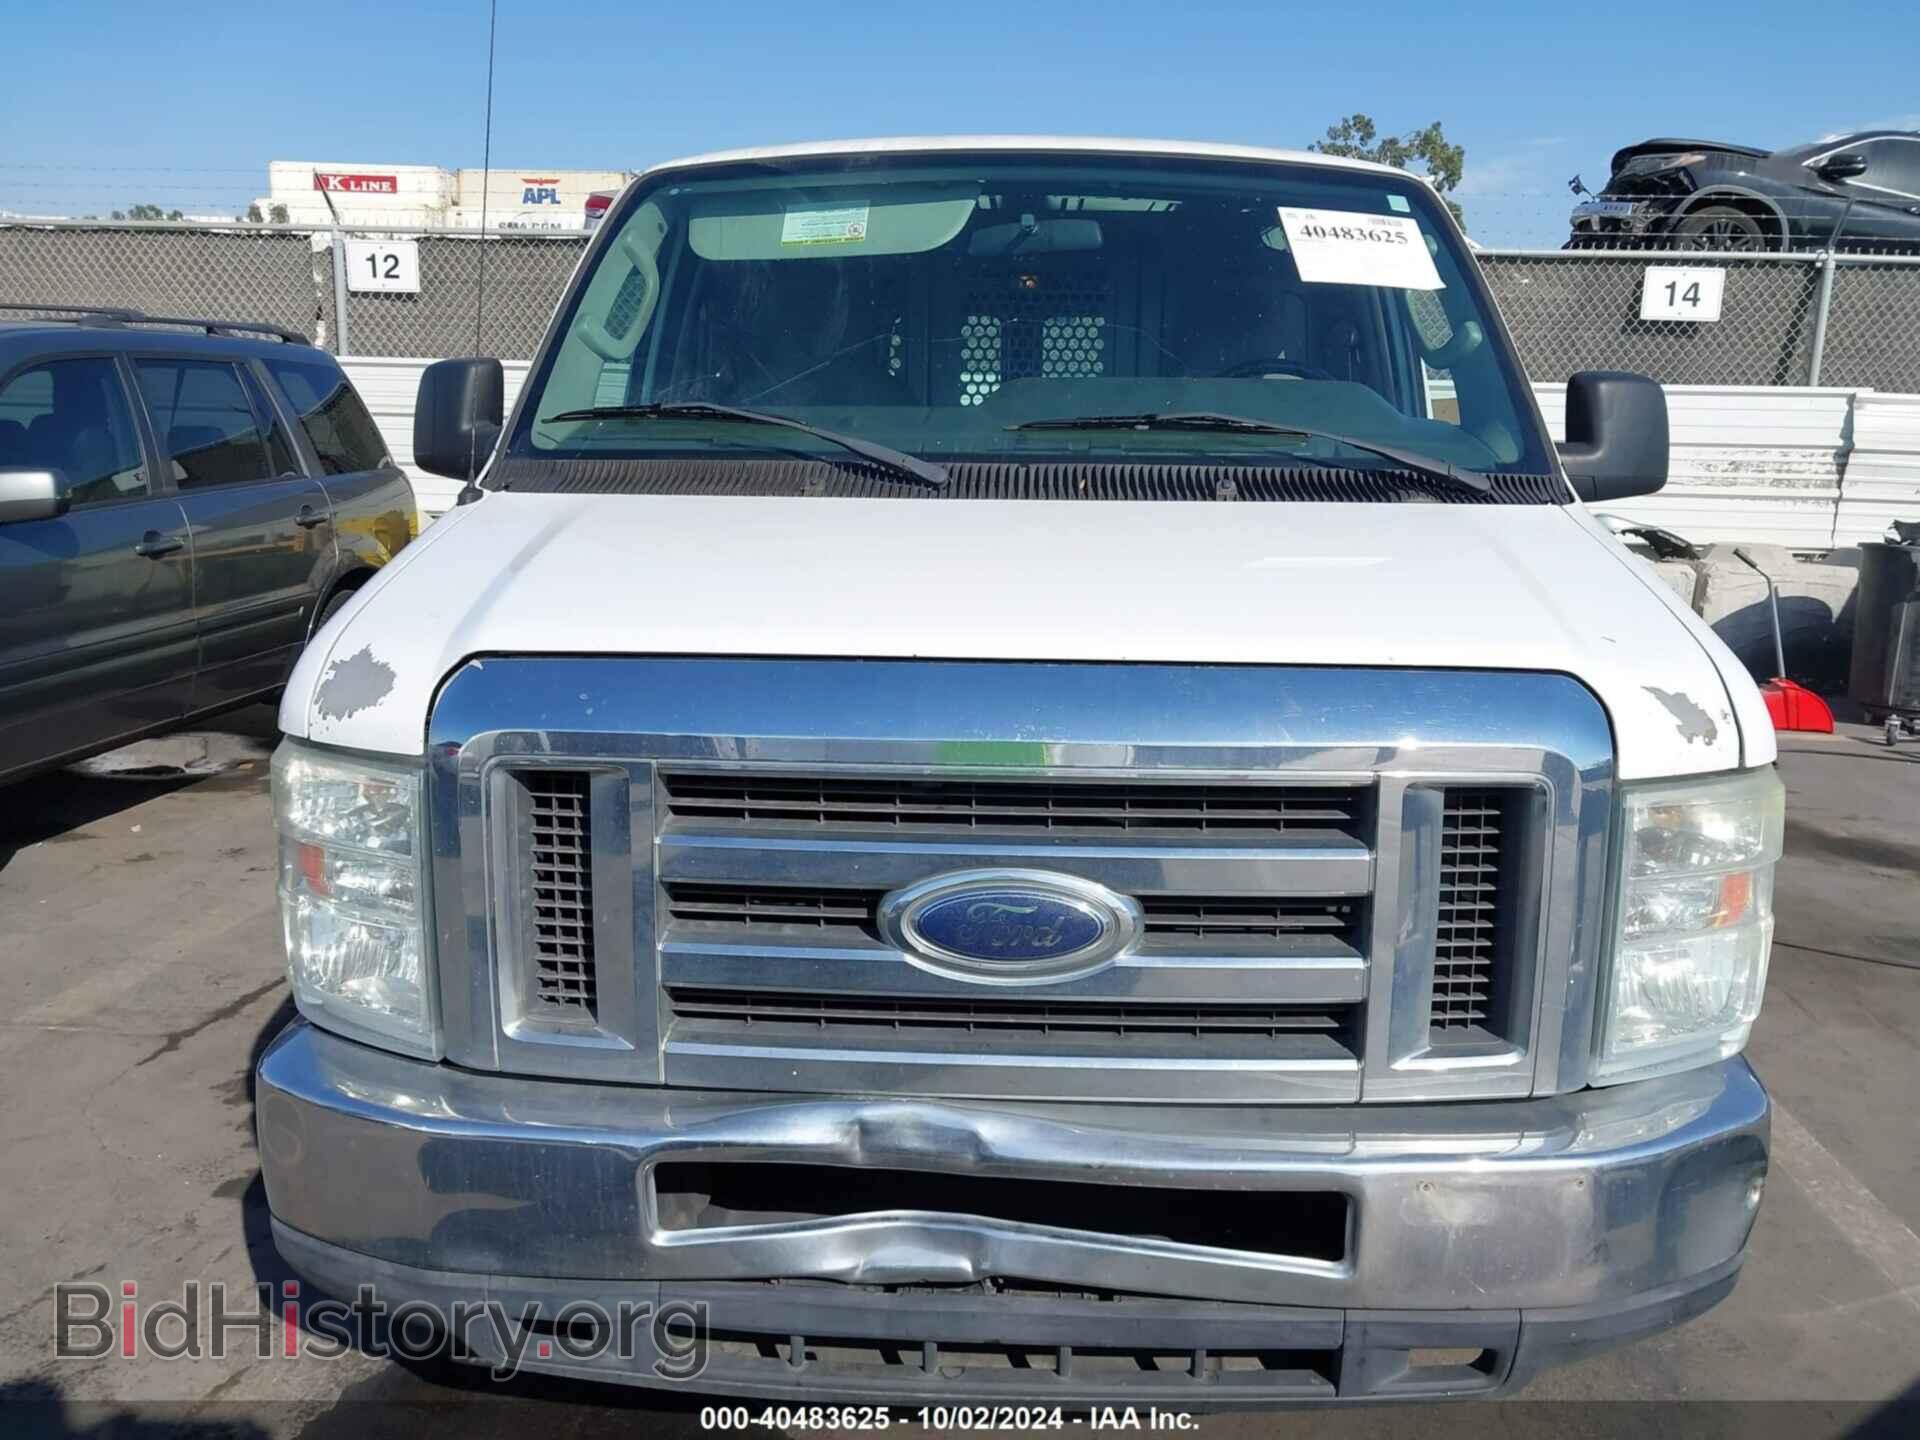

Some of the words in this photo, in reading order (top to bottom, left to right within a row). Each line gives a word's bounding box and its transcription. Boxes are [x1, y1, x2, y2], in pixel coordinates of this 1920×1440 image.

[327, 175, 347, 191] K
[349, 180, 392, 192] LINE
[522, 187, 561, 204] APL
[1300, 223, 1408, 245] 40483625
[365, 252, 400, 279] 12
[1664, 280, 1701, 307] 14
[958, 902, 1073, 946] Ford
